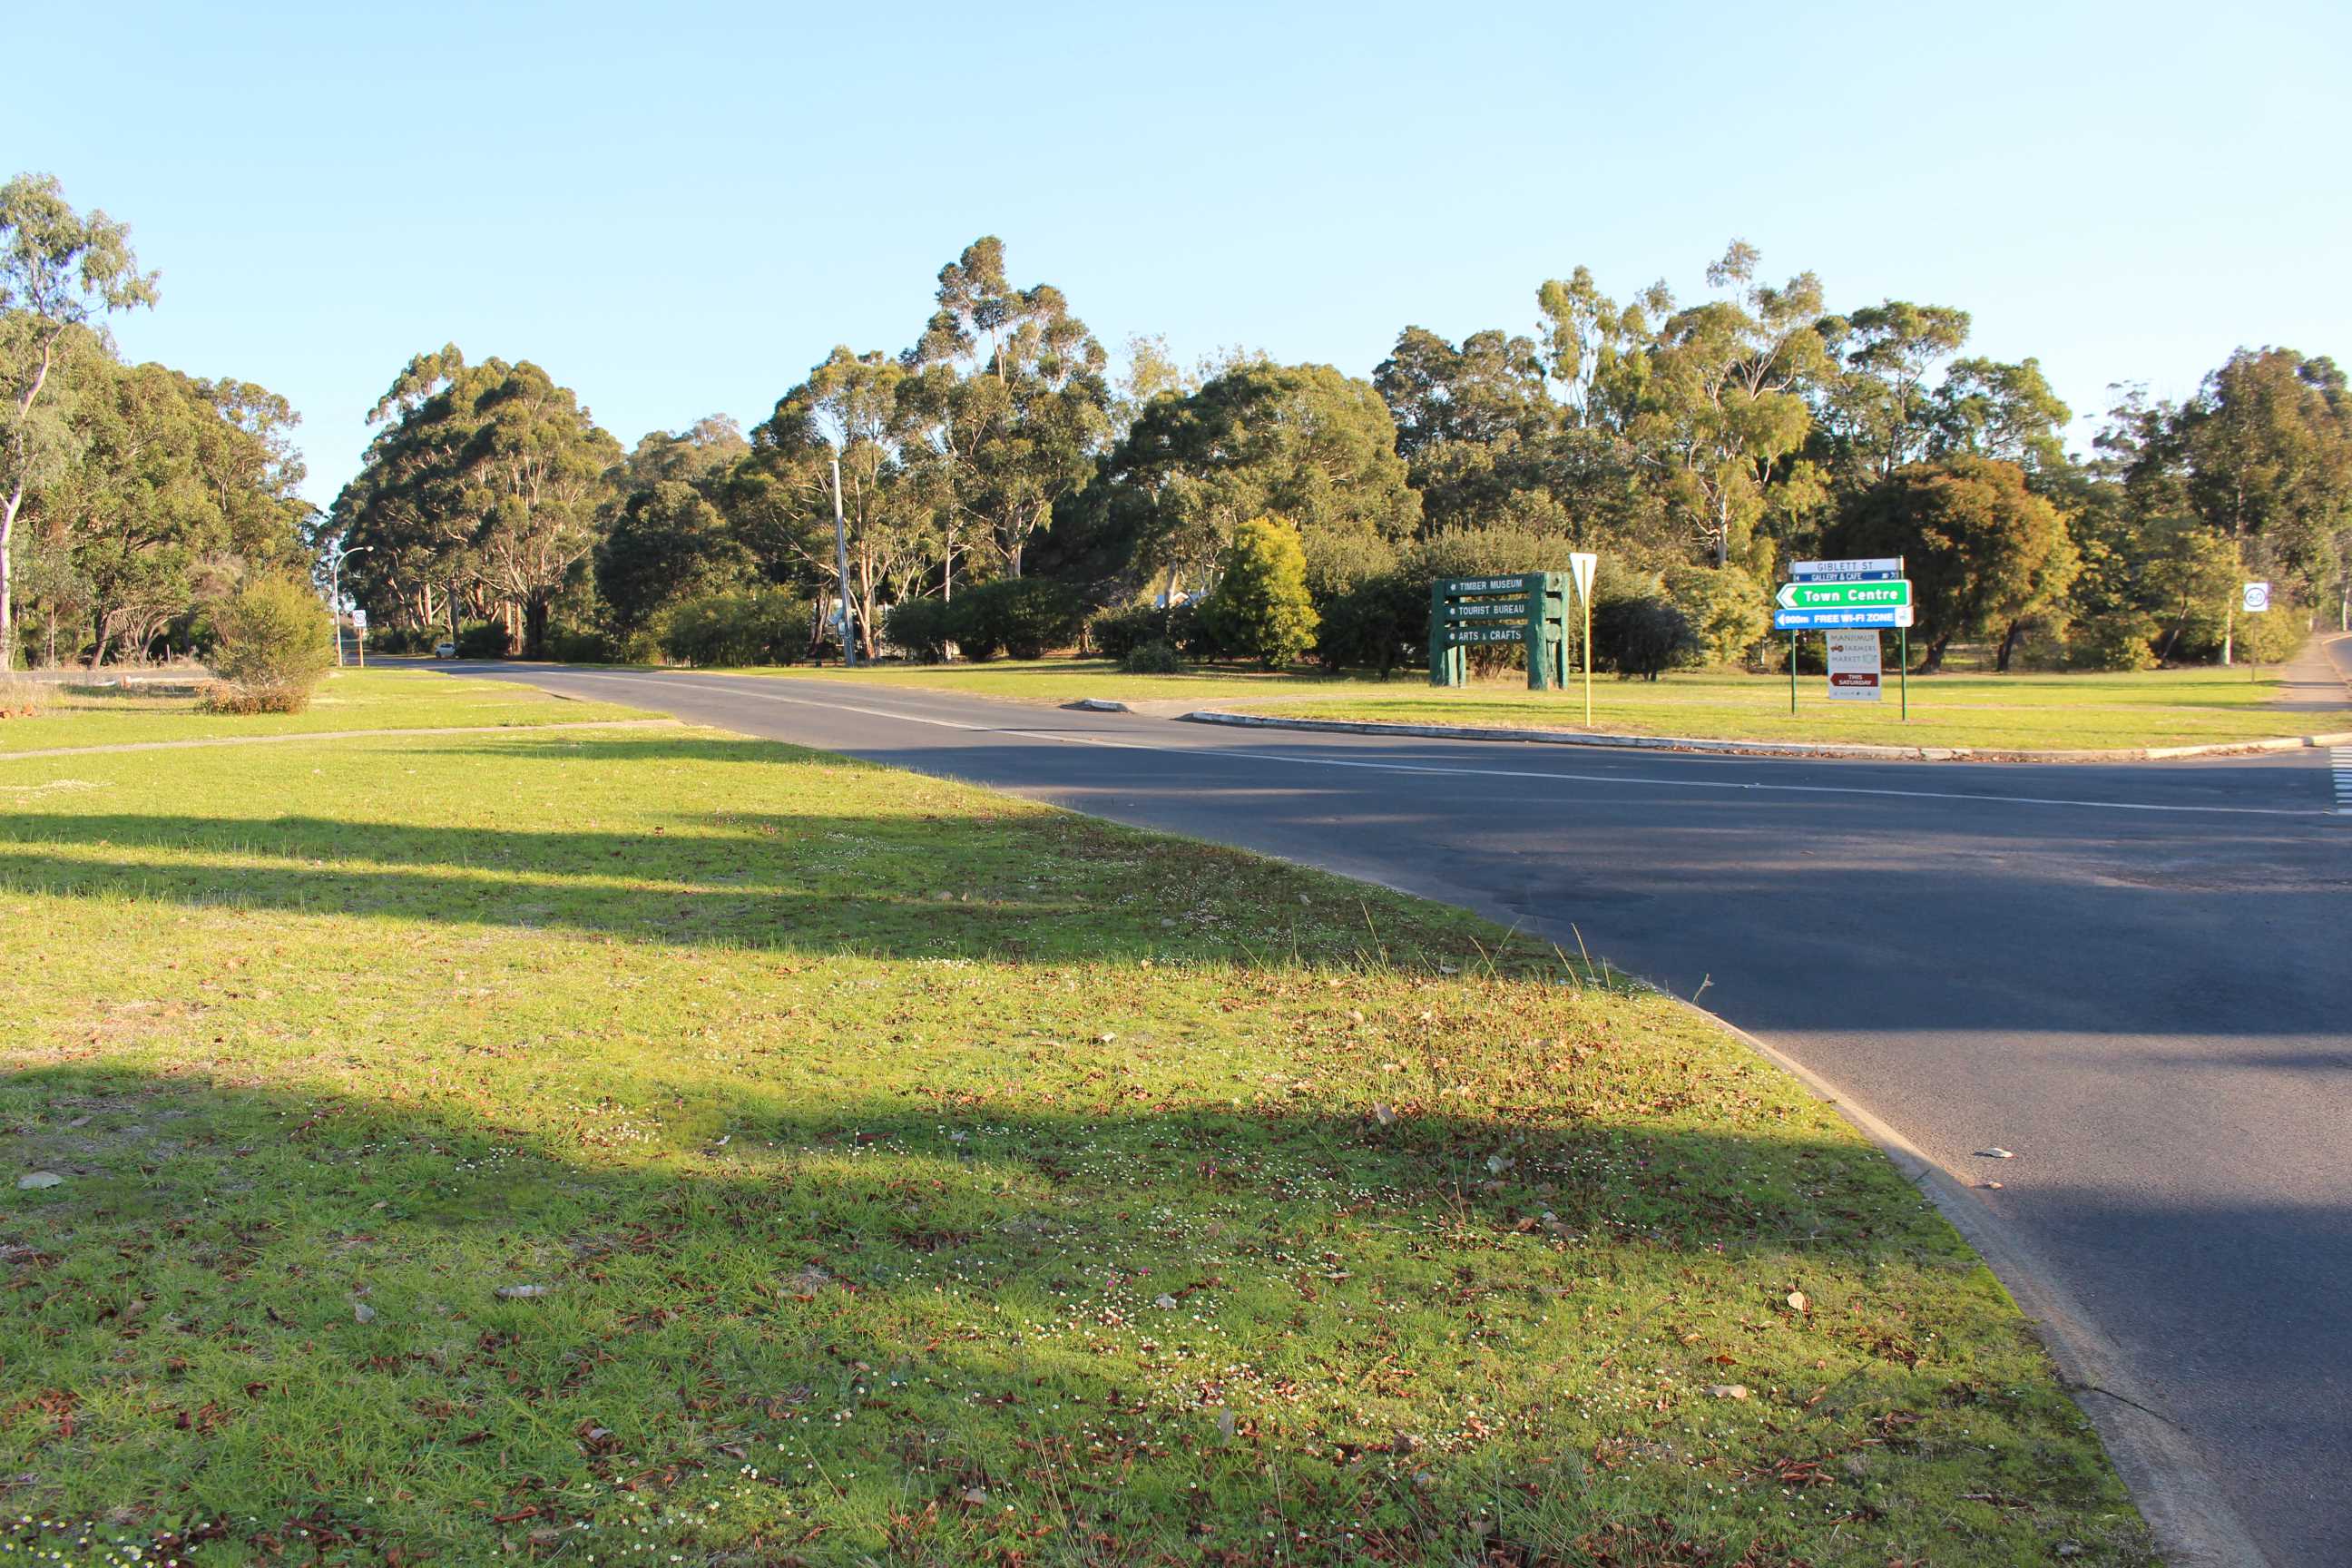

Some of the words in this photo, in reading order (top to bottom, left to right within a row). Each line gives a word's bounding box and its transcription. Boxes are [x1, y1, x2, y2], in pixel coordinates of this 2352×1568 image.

[1818, 563, 1859, 572] GIBLETT
[1862, 562, 1874, 570] ST
[1459, 582, 1486, 591] TIMBER
[1490, 579, 1523, 589] MUSEUM
[1804, 590, 1840, 603] Town
[1847, 589, 1898, 602] Centre
[1459, 605, 1490, 615] TOURIST
[1494, 604, 1524, 614] BUREAU
[1814, 614, 1839, 623] FREE
[1840, 613, 1866, 623] WI-FI
[1867, 612, 1894, 622] ZONE
[1459, 631, 1479, 641] ARTS
[1490, 630, 1522, 640] CRAFTS
